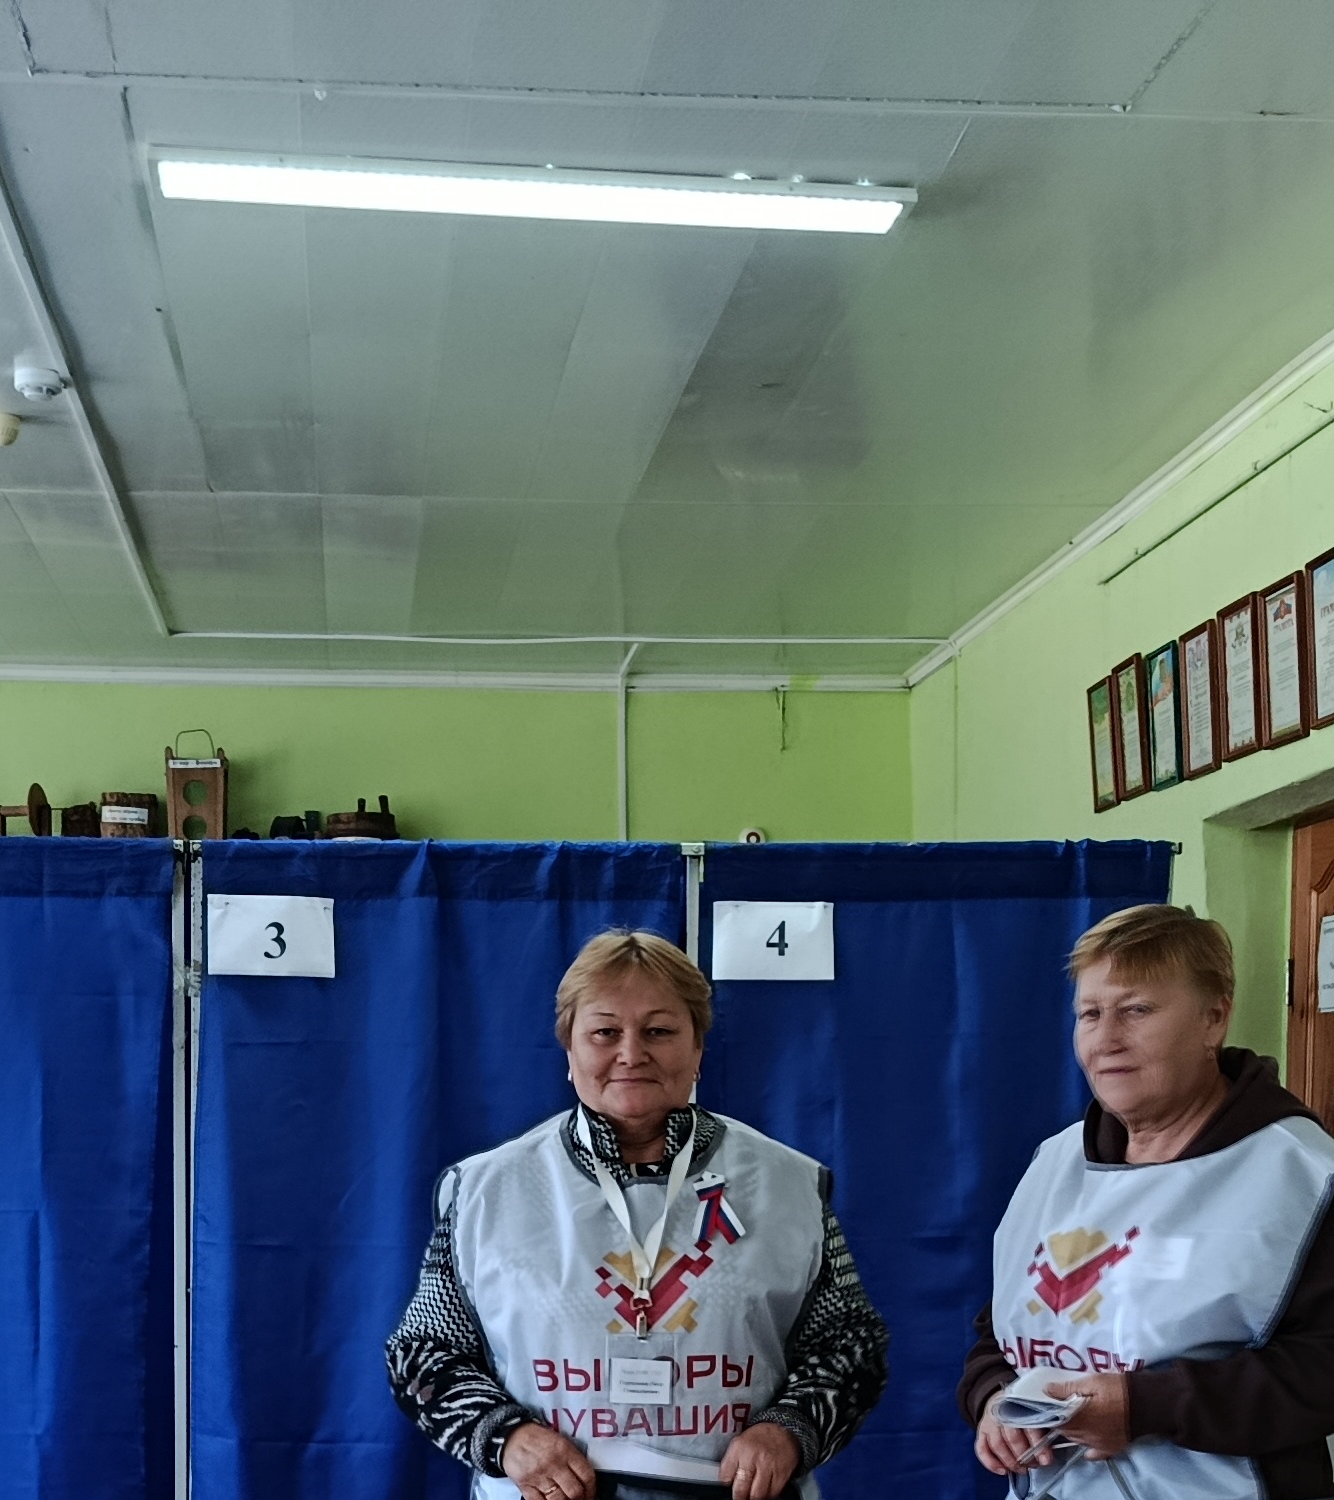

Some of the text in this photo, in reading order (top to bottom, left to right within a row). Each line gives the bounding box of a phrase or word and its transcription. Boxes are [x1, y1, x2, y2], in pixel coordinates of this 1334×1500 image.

[263, 921, 287, 959] 3
[765, 920, 789, 957] 4
[533, 1355, 754, 1391] ВЫРЫ
